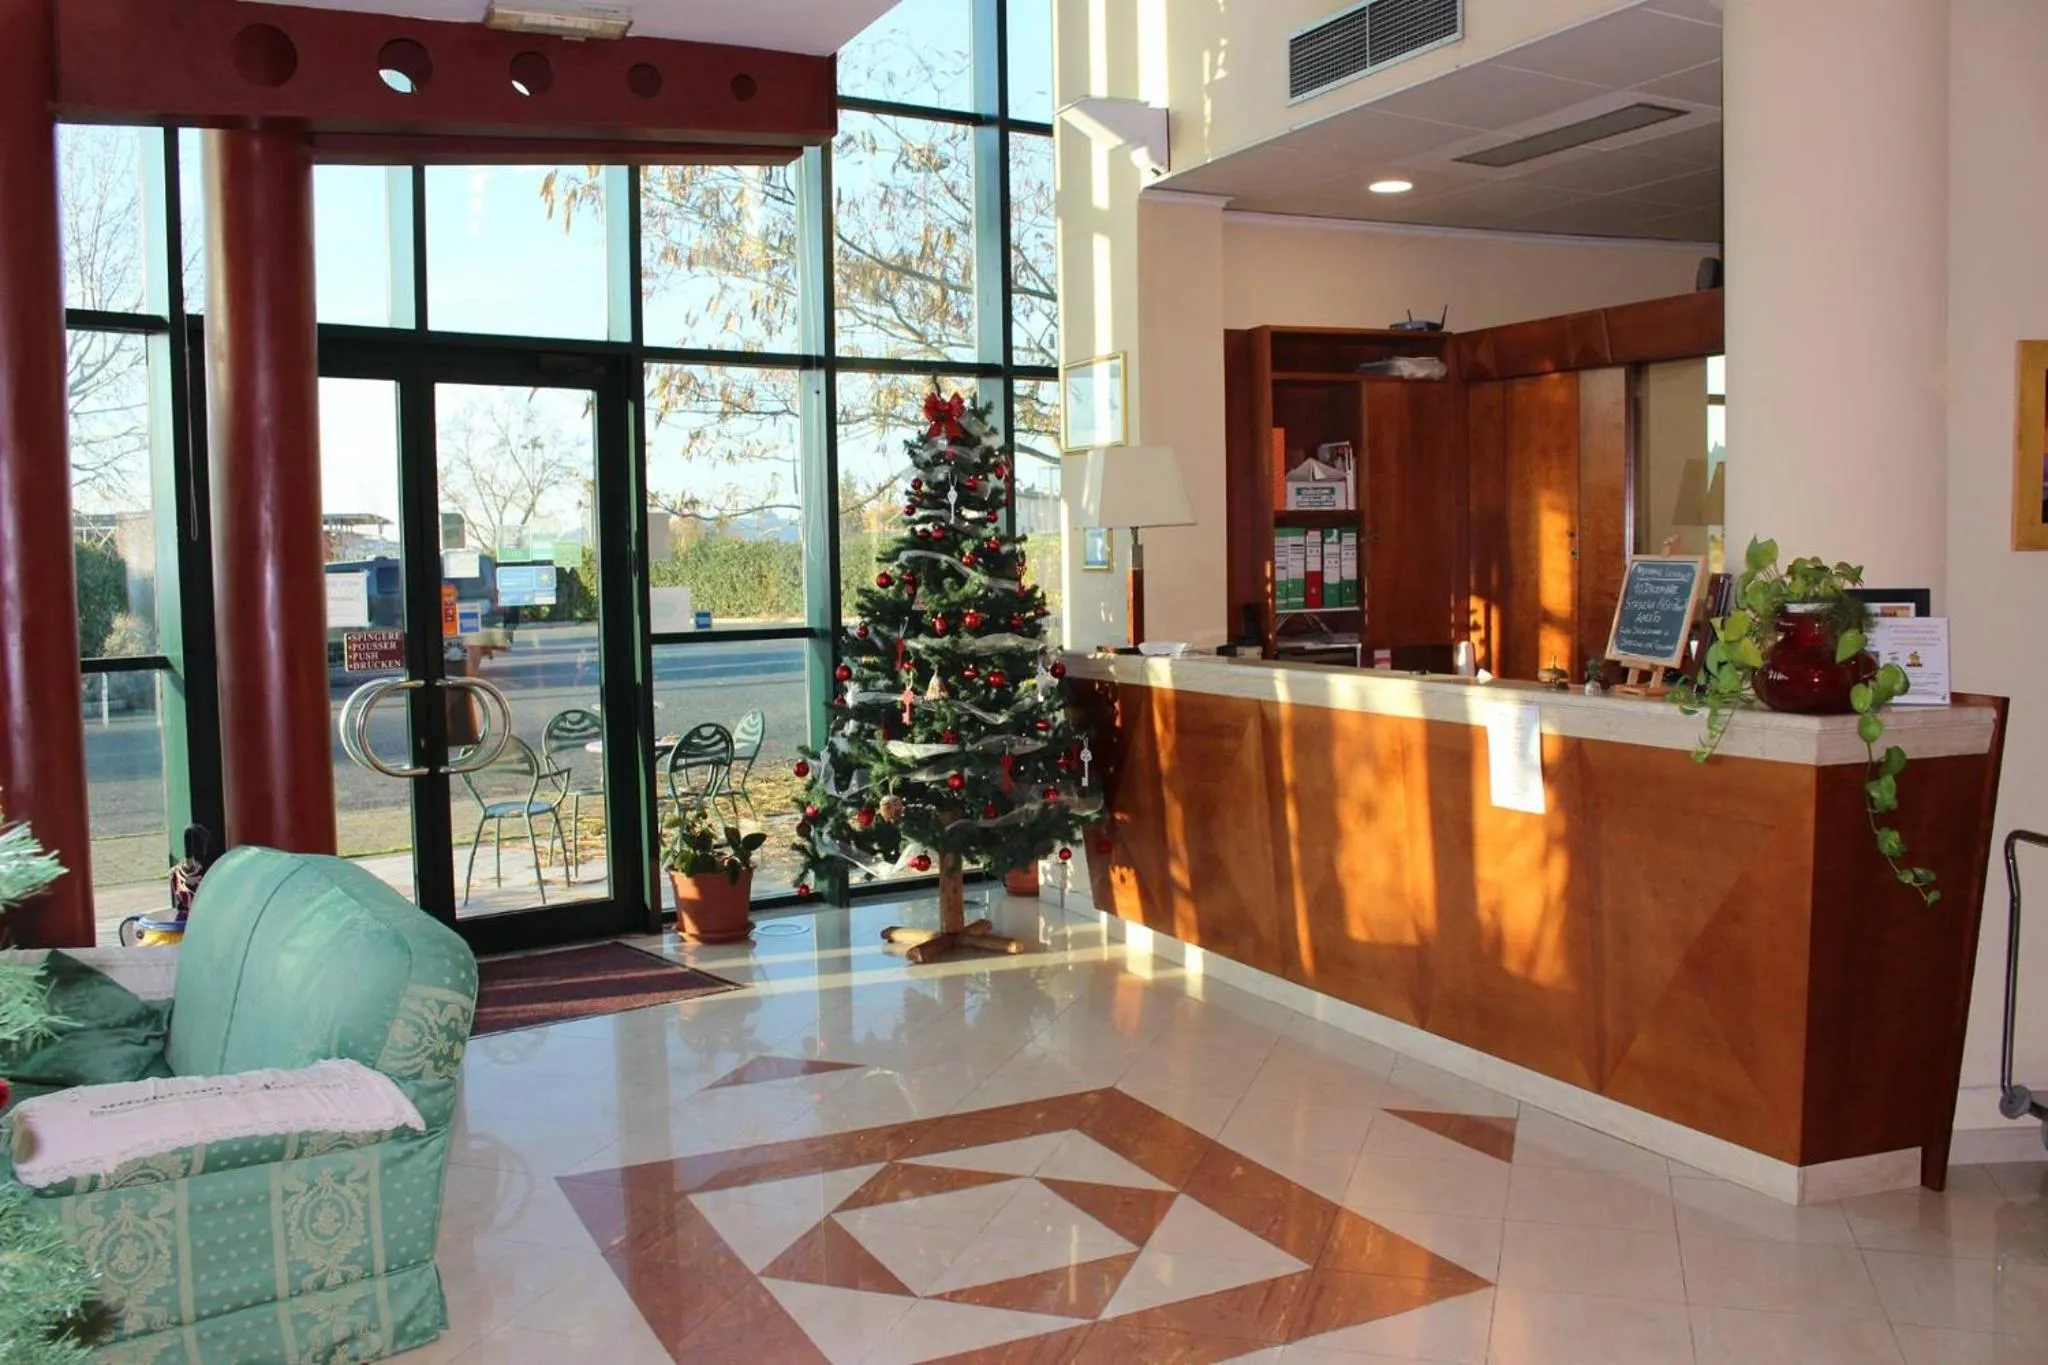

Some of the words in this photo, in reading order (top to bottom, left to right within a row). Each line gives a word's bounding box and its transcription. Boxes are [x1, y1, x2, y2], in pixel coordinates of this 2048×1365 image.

[351, 631, 401, 641] SPINGERE
[352, 641, 397, 651] POUSSER
[352, 651, 378, 661] PUSH
